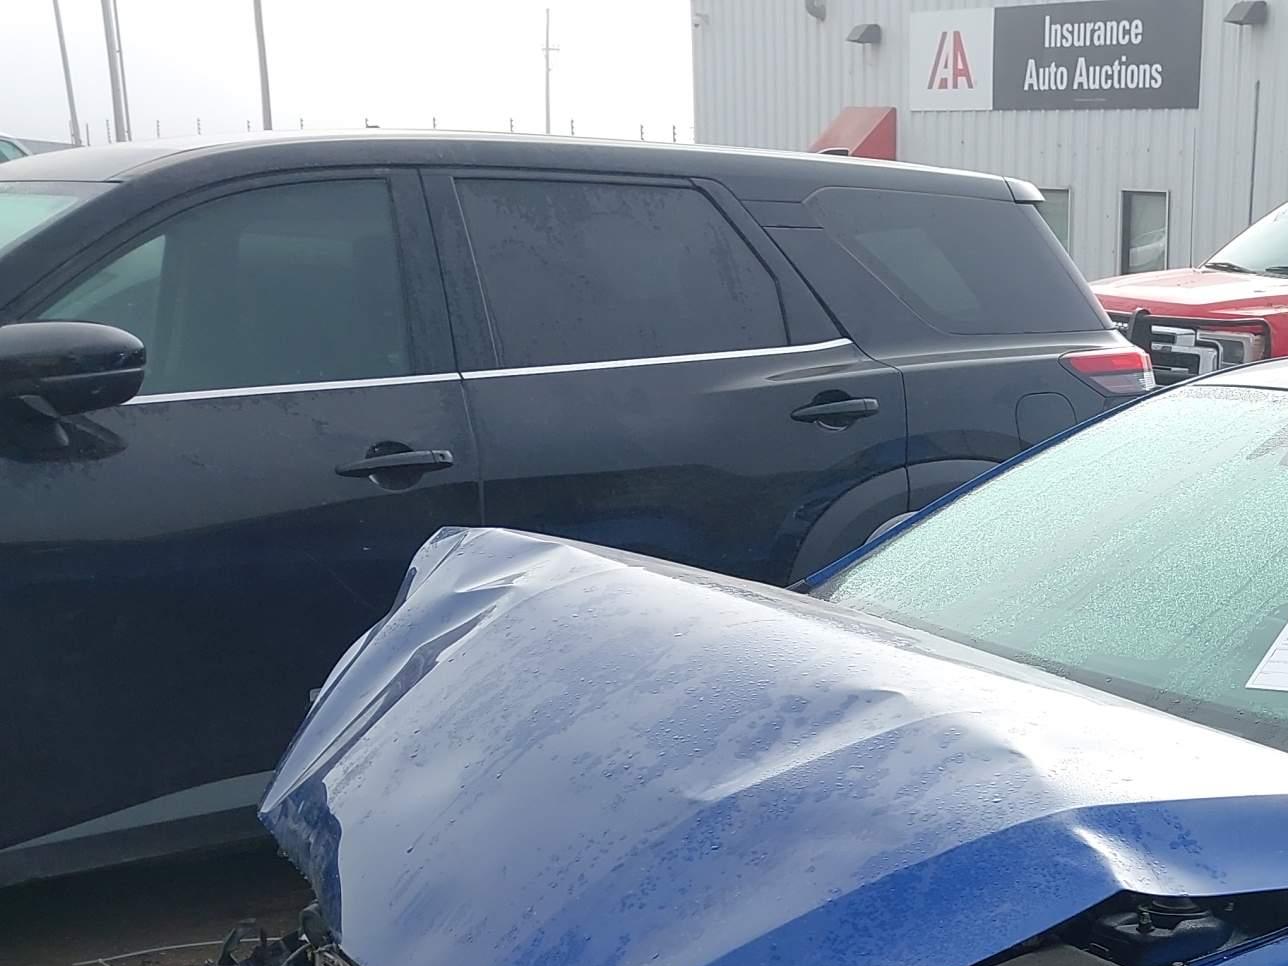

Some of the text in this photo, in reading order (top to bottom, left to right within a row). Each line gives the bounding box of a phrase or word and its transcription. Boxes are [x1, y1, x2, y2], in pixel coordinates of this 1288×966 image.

[1044, 15, 1144, 49] Insurance
[1023, 56, 1162, 91] Auto Auctions
